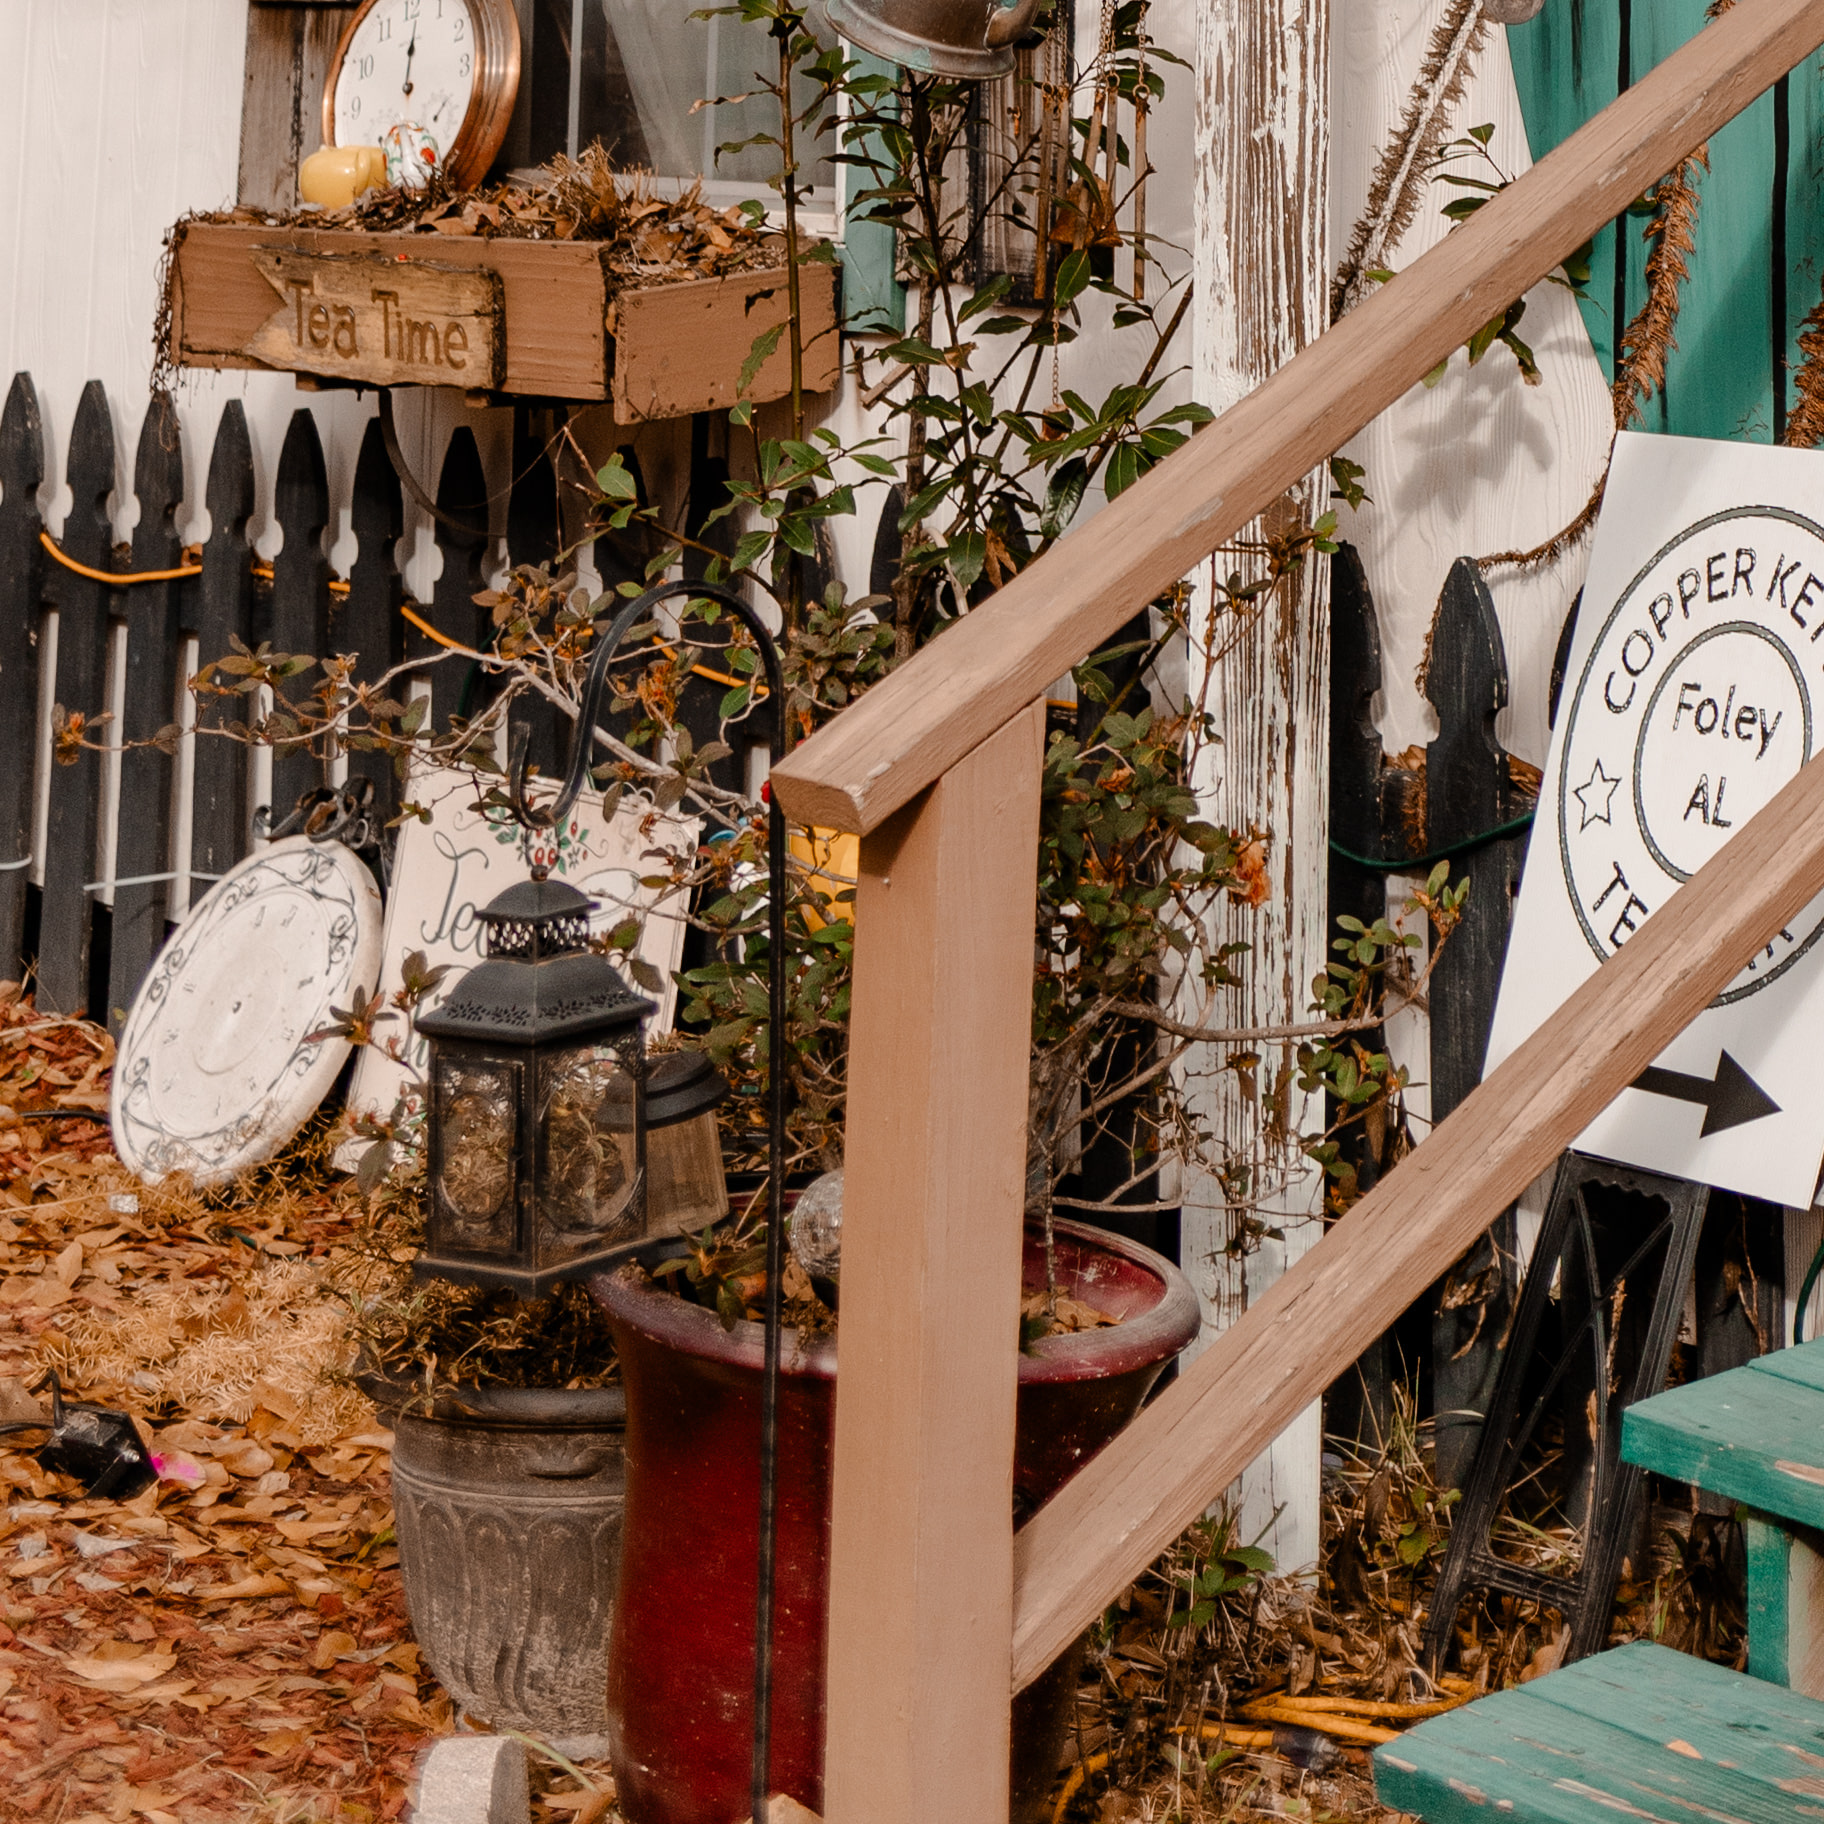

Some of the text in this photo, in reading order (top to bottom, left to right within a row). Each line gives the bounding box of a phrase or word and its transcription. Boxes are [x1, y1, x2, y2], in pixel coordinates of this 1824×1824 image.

[377, 17, 391, 44] 11
[453, 18, 464, 43] 2
[359, 54, 374, 81] 10
[459, 53, 470, 78] 3
[351, 96, 361, 121] 9
[284, 277, 469, 371] Tea Time
[1604, 547, 1756, 714] COPPER
[1671, 682, 1783, 761] Foley
[1683, 773, 1732, 828] AL
